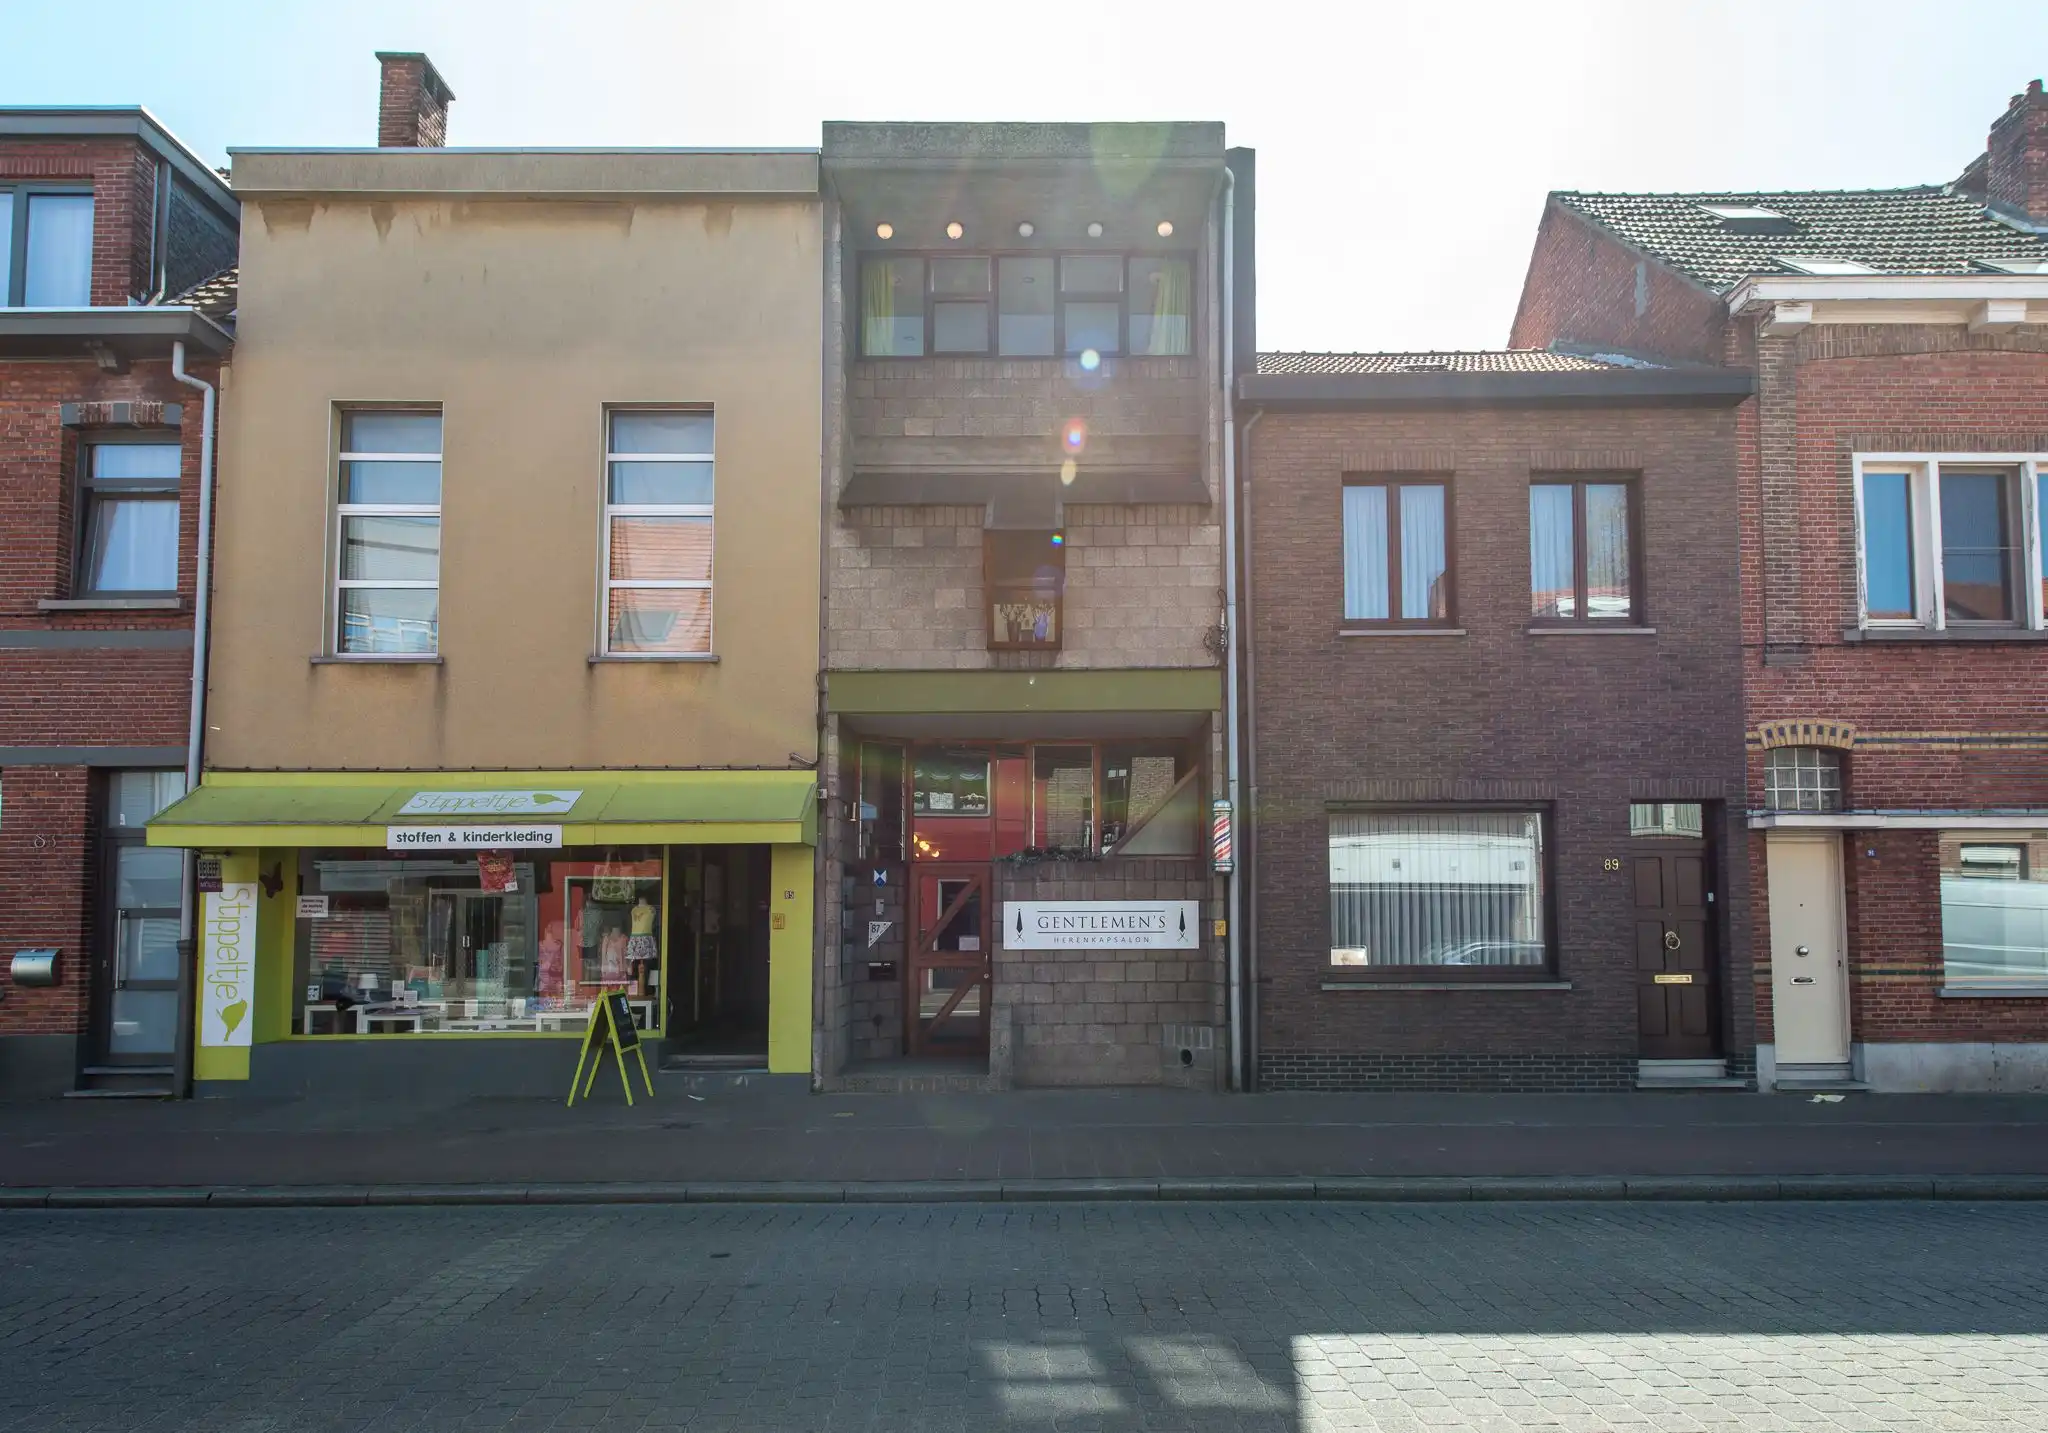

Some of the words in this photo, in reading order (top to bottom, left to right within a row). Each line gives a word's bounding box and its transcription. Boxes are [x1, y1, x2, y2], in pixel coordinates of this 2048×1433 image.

[410, 793, 530, 812] Stippeltje
[396, 831, 442, 843] stoffen
[447, 831, 457, 843] &
[463, 831, 553, 844] kinderkleding
[1604, 858, 1619, 870] 89
[1037, 914, 1167, 929] GENTLEMEN'S
[871, 924, 881, 933] 87
[207, 887, 250, 999] Stippeltje
[1053, 936, 1151, 944] HERENKAPSALON
